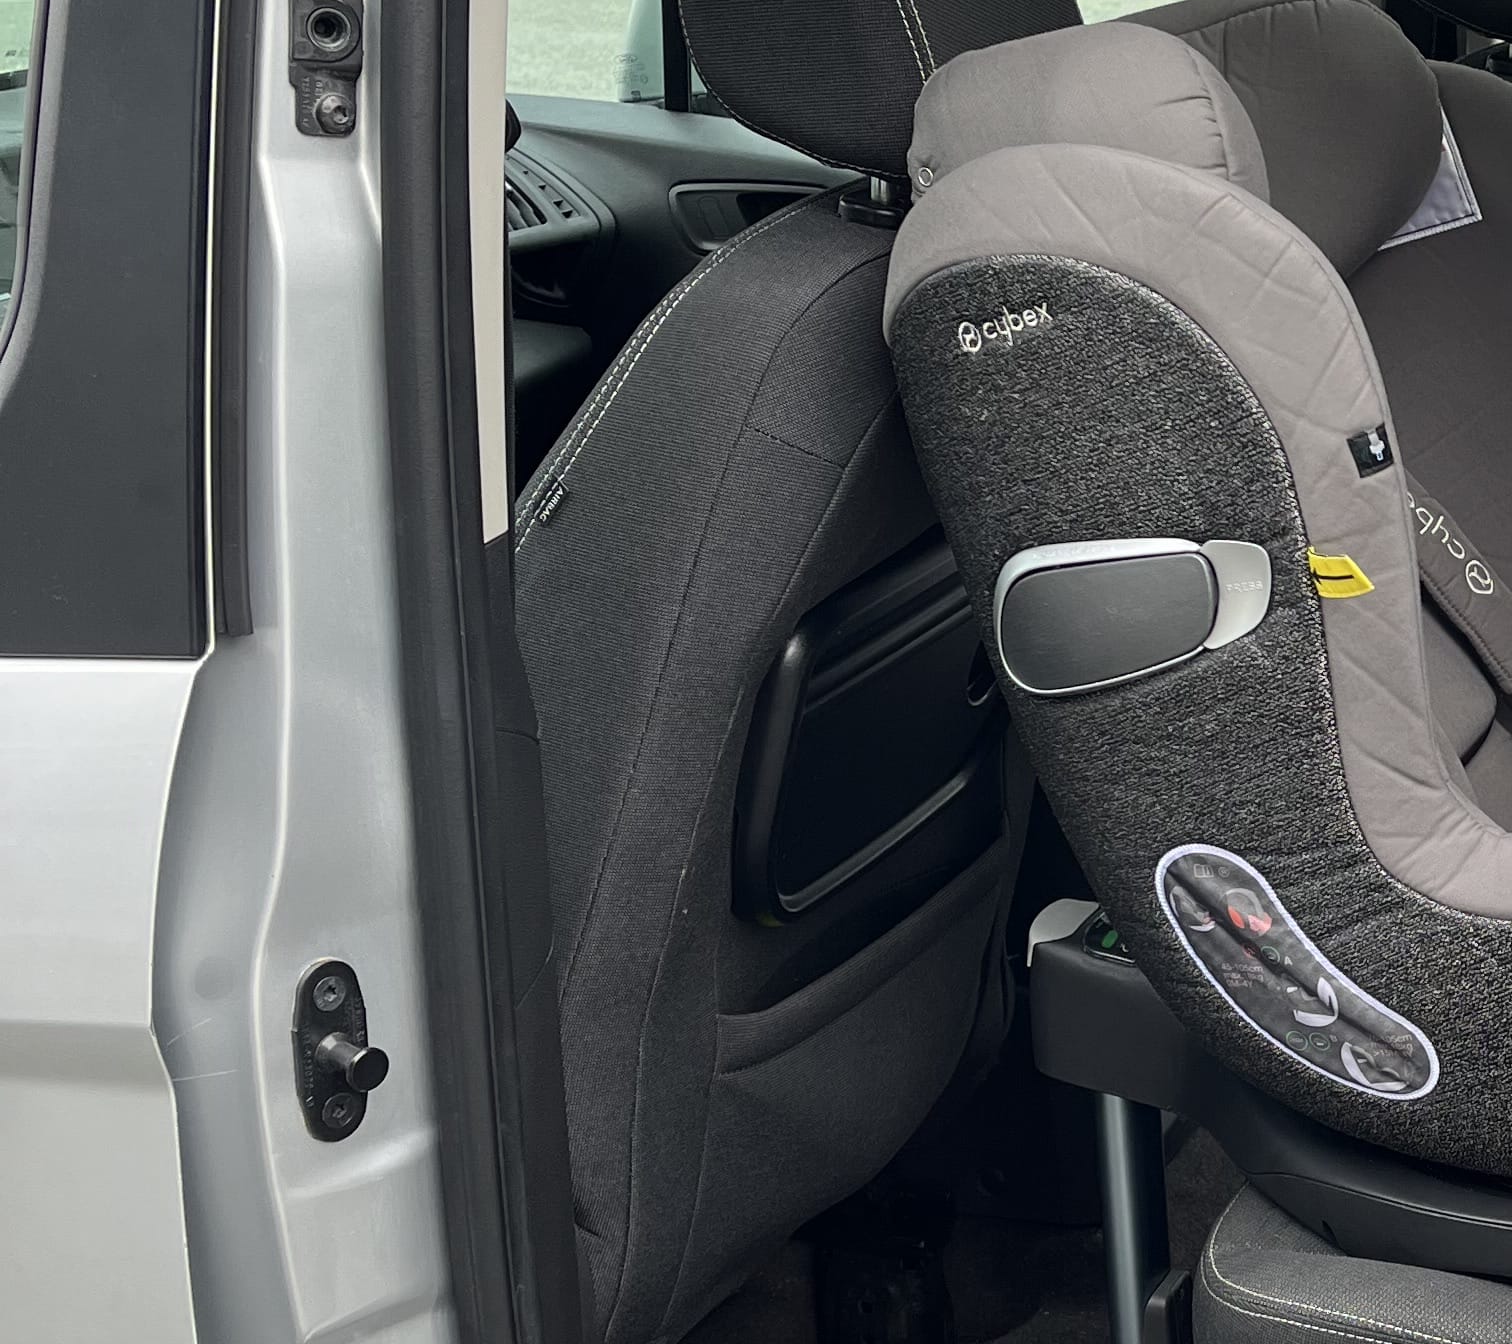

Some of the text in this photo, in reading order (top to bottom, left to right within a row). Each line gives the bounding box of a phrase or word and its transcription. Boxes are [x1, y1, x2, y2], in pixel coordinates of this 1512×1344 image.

[982, 301, 1054, 346] cybex
[539, 485, 564, 522] AIRBAG
[1225, 580, 1264, 593] PRESS
